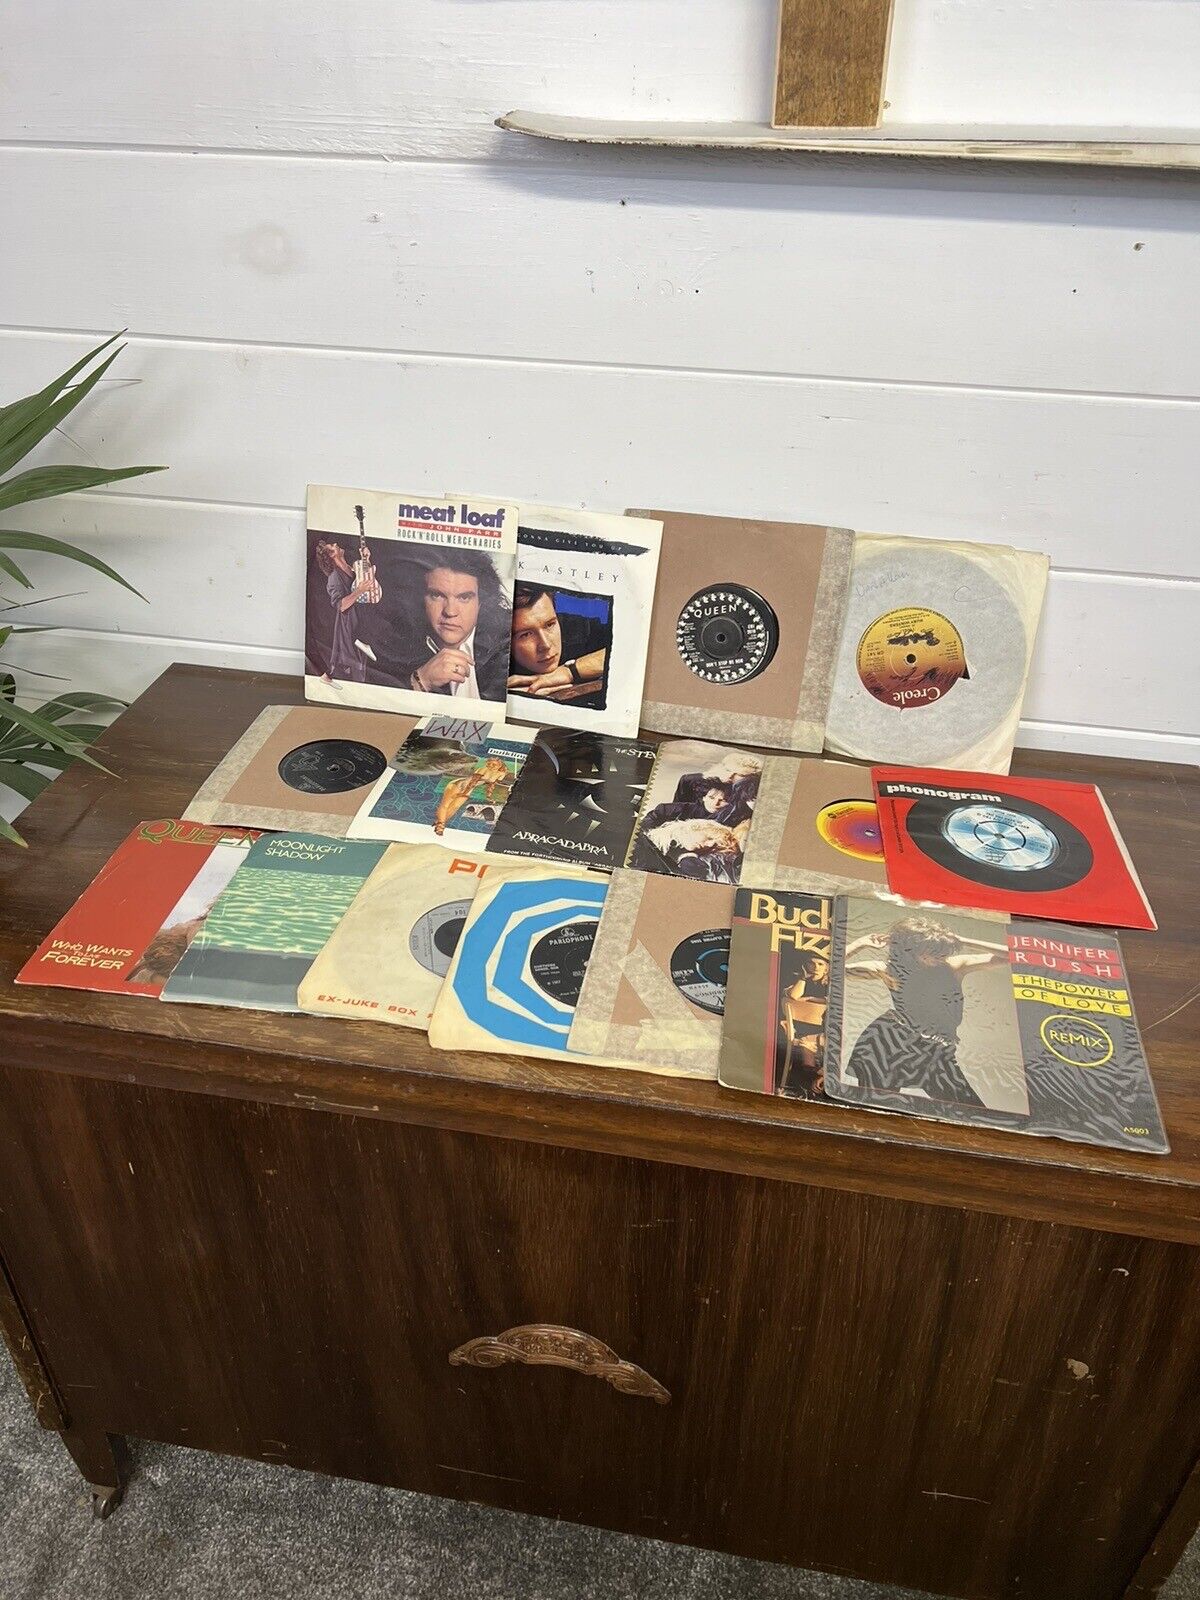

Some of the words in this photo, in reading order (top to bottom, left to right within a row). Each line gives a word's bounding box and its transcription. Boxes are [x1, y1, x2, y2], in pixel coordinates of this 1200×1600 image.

[399, 503, 456, 523] meat
[461, 504, 506, 529] loaf
[429, 524, 461, 533] JOHN
[468, 529, 500, 538] PARR
[517, 533, 549, 542] ONNA
[446, 535, 502, 550] MERCENARIES
[542, 564, 620, 583] ASTLEY
[693, 604, 738, 619] QUEEN
[893, 686, 941, 705] Creole
[426, 718, 488, 741] WAX
[886, 784, 1002, 803] phonogram
[269, 839, 346, 854] MOONLIGHT
[512, 830, 609, 856] ABRACADABRA
[264, 847, 325, 861] SHADOW
[51, 939, 84, 951] WHO
[86, 944, 134, 957] WANTS
[548, 934, 594, 946] PARLOPHONE
[1012, 935, 1110, 960] JENNIFER
[40, 950, 125, 970] FOREVER
[1015, 951, 1112, 977] RUSH
[317, 994, 379, 1009] EX-JUKE
[387, 1004, 418, 1017] BOX
[1021, 988, 1048, 1000] OF
[1062, 997, 1122, 1014] LOVE
[1049, 1029, 1104, 1049] REMIX
